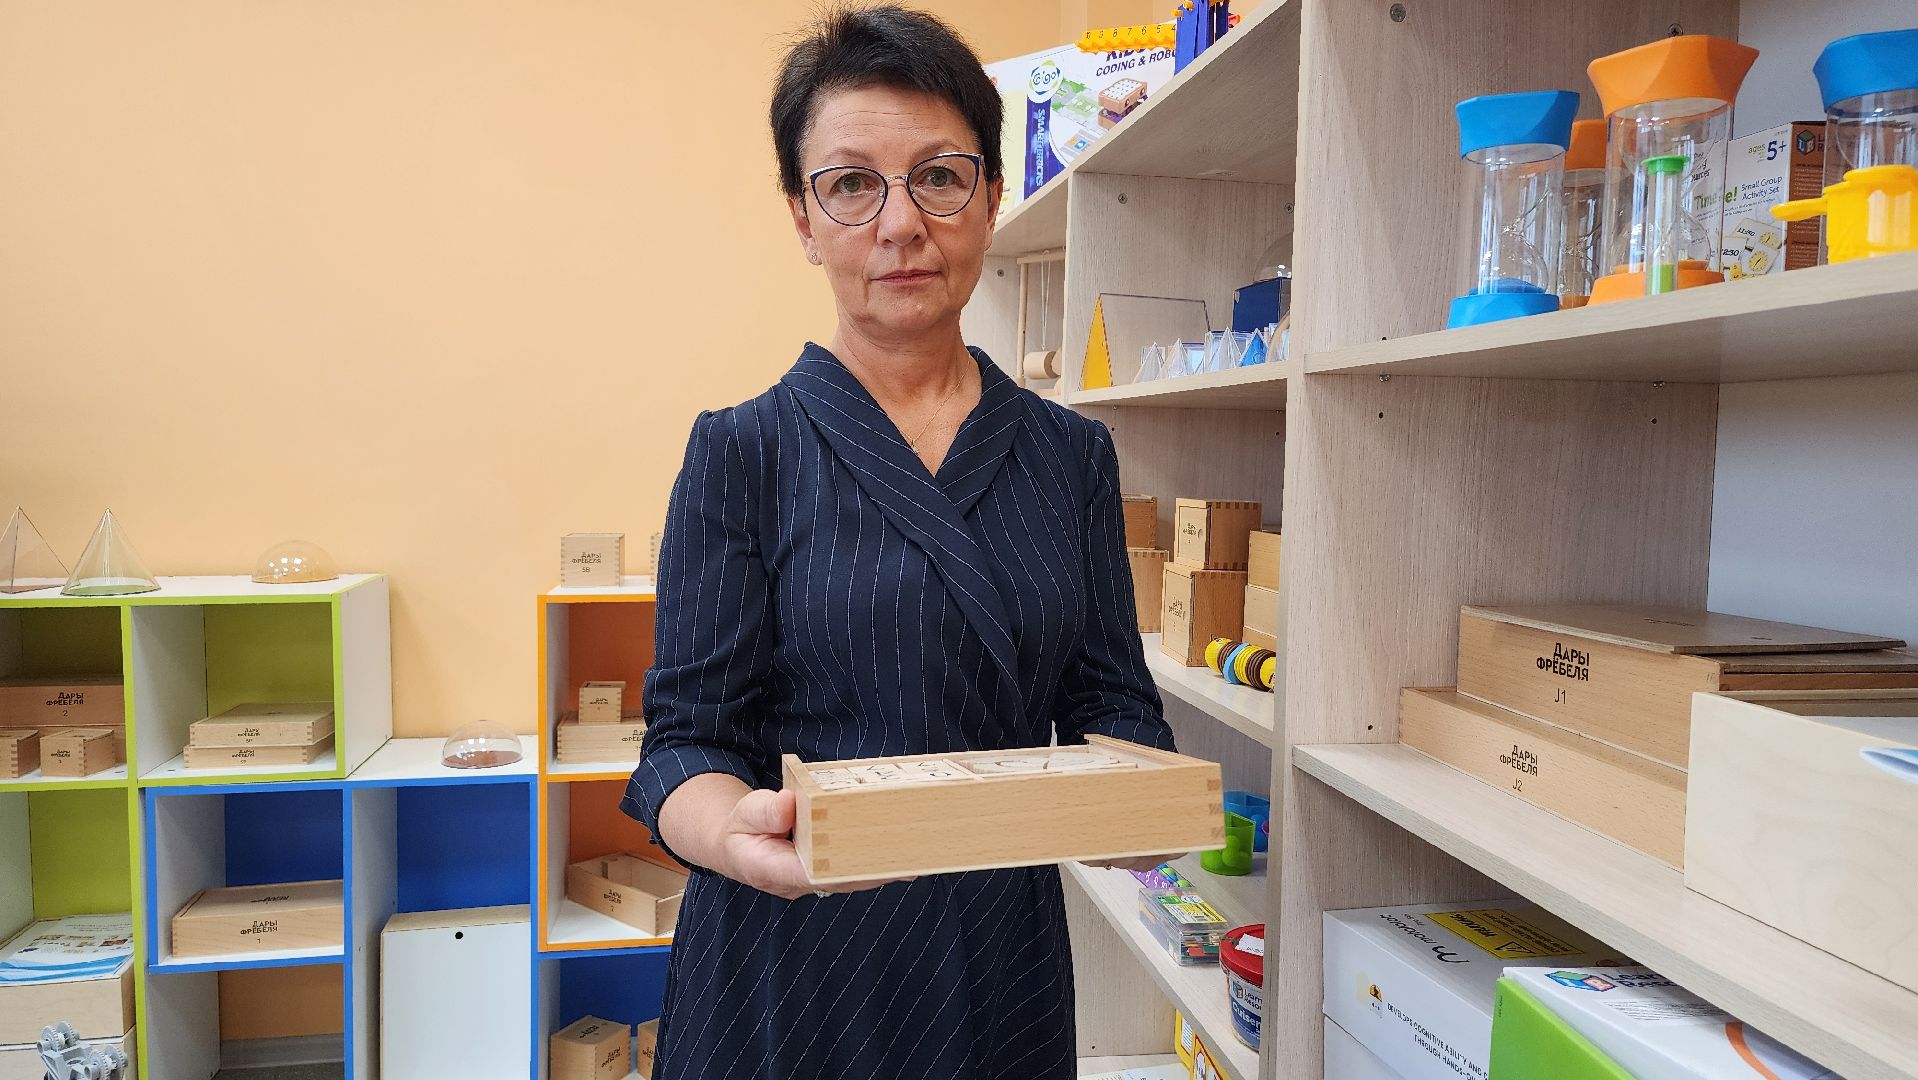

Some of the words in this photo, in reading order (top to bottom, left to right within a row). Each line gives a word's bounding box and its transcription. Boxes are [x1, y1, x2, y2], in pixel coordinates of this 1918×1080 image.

[1096, 59, 1135, 77] CODING
[1138, 56, 1146, 66] &
[1767, 140, 1787, 161] 5+
[1741, 180, 1760, 192] Small
[1761, 175, 1783, 188] Group
[1742, 189, 1769, 201] Activity
[1769, 186, 1780, 195] Set
[1553, 642, 1590, 667] ДАРЫ
[58, 691, 84, 700] ДАРЫ
[1554, 687, 1566, 705] J1
[62, 709, 68, 717] 2
[1512, 744, 1538, 766] ДАРЫ
[1512, 778, 1523, 792] J2
[252, 920, 278, 928] ДАРЫ
[1413, 1021, 1444, 1049] COGNITIVE
[1414, 1033, 1441, 1060] THROUGH
